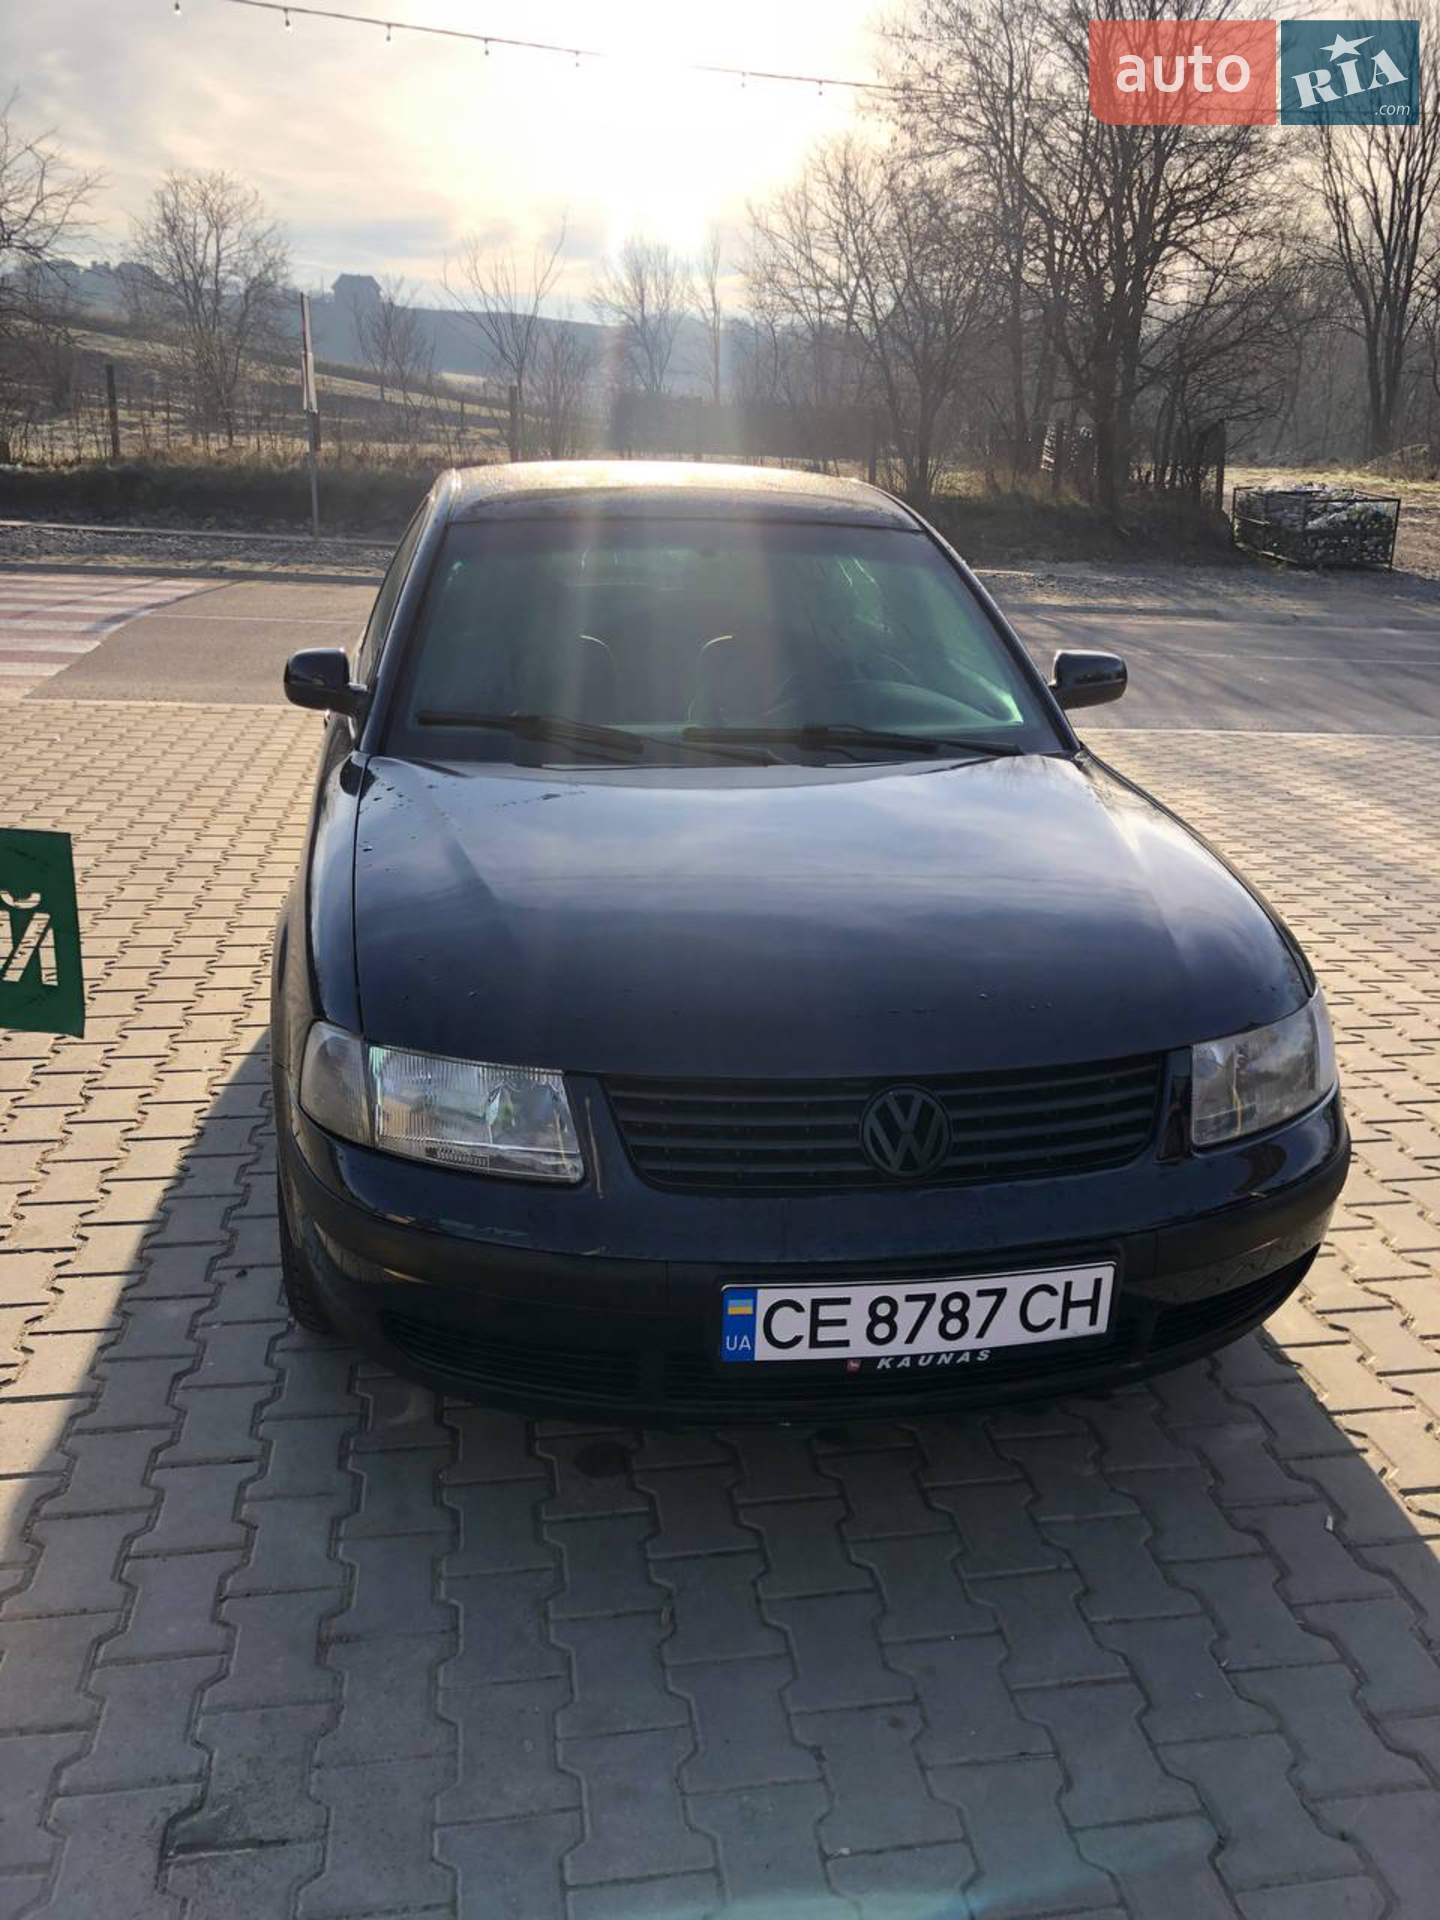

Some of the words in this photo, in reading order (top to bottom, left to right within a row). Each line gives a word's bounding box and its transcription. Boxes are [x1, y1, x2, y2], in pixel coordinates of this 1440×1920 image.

[762, 1297, 852, 1350] CE
[865, 1287, 1007, 1346] 8787
[1018, 1277, 1103, 1333] CH
[726, 1336, 752, 1351] UA
[876, 1349, 991, 1370] KAUNAS
